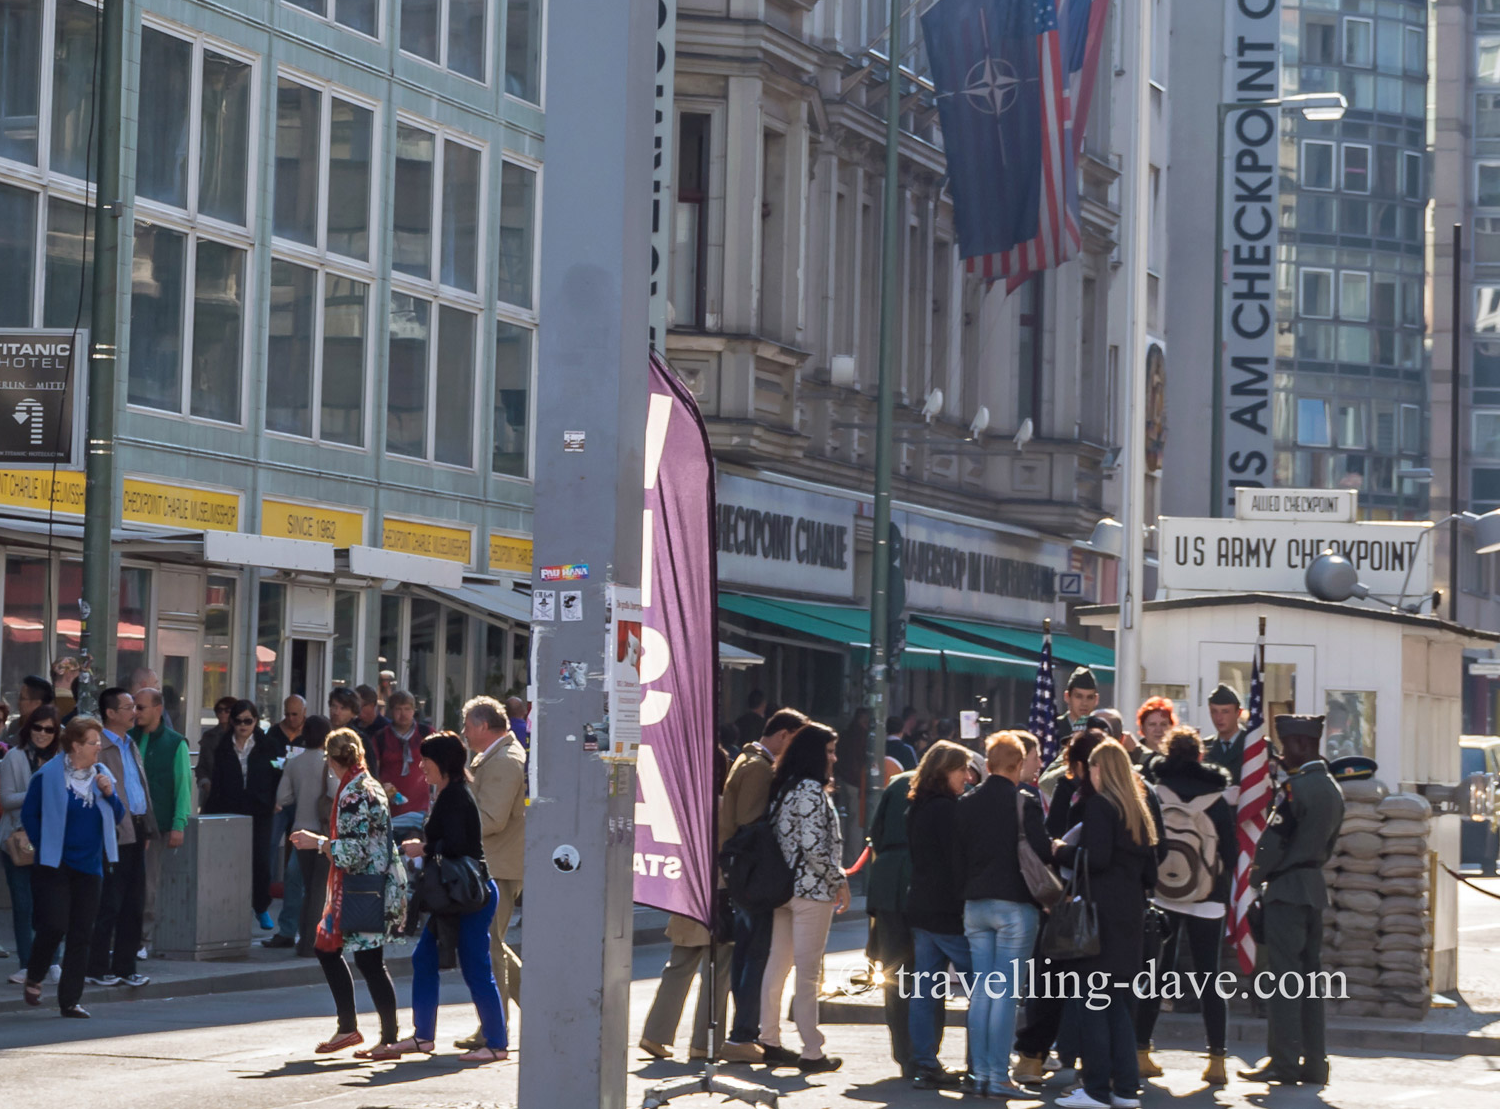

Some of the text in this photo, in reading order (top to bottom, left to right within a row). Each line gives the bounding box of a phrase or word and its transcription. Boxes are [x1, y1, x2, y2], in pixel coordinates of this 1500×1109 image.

[1231, 37, 1276, 341] CHECKPOINT
[1229, 356, 1269, 434] AM
[10, 474, 39, 500] CHARLIE
[123, 490, 237, 526] CHECKPOINT CHARLIE MUSEUMSSHOP
[1251, 495, 1340, 513] ALLIED CHECKPOINT
[287, 514, 337, 540] SINCE 1962
[716, 502, 848, 571] HECKPOINT CHARLIE
[1175, 536, 1206, 567] US
[1217, 536, 1277, 569] ARMY
[540, 566, 589, 579] PAU HANA
